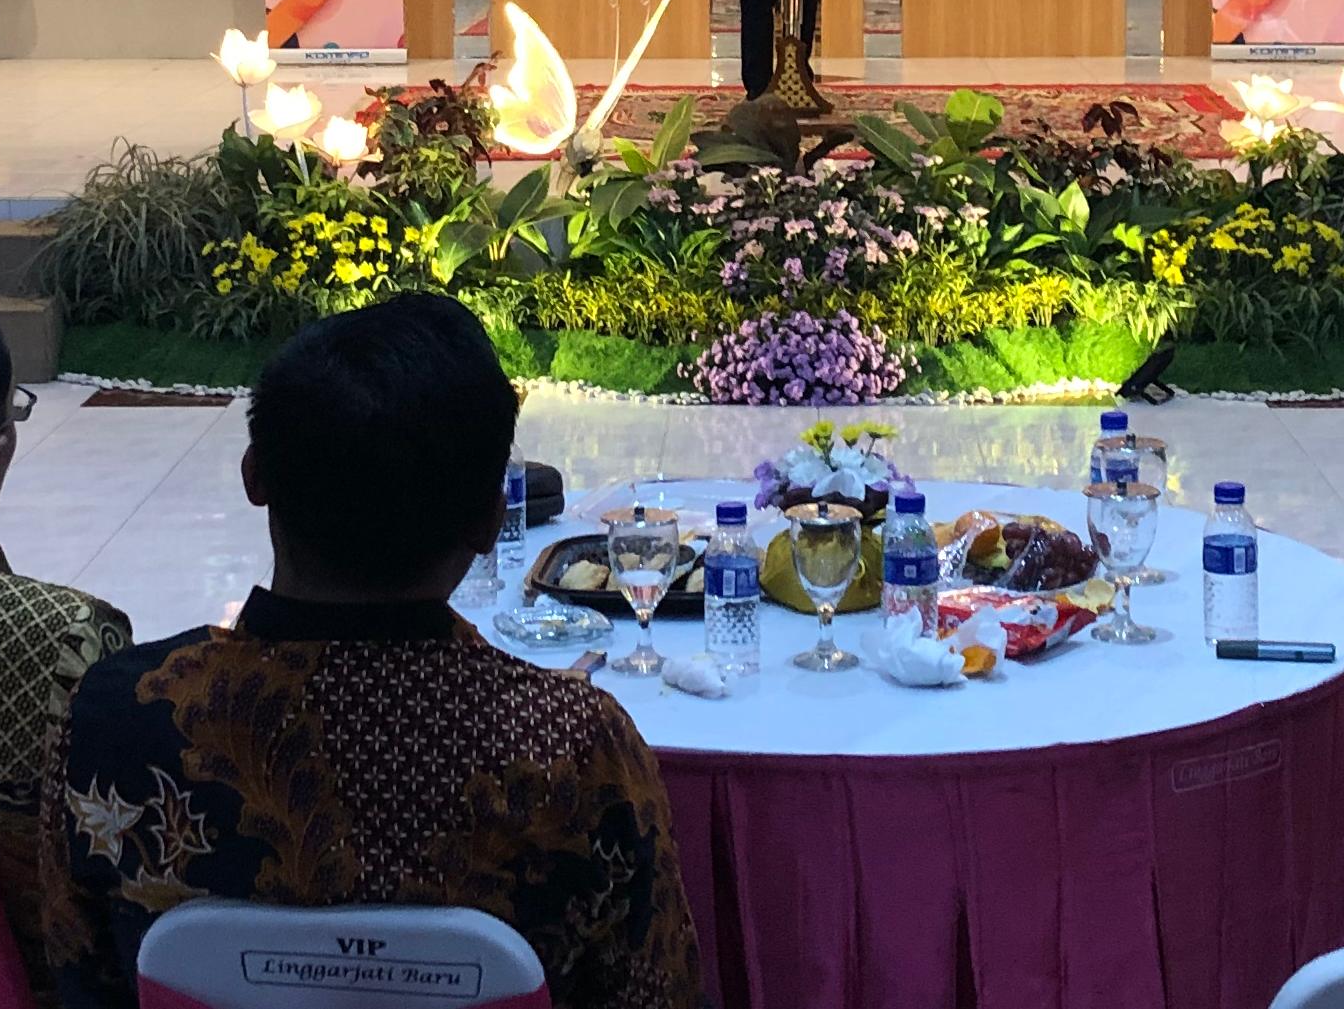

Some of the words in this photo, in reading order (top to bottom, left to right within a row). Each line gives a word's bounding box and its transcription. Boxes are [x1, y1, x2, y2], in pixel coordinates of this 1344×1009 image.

[336, 937, 387, 956] VIP
[263, 958, 394, 984] Linggarjati
[401, 968, 462, 986] Baru
